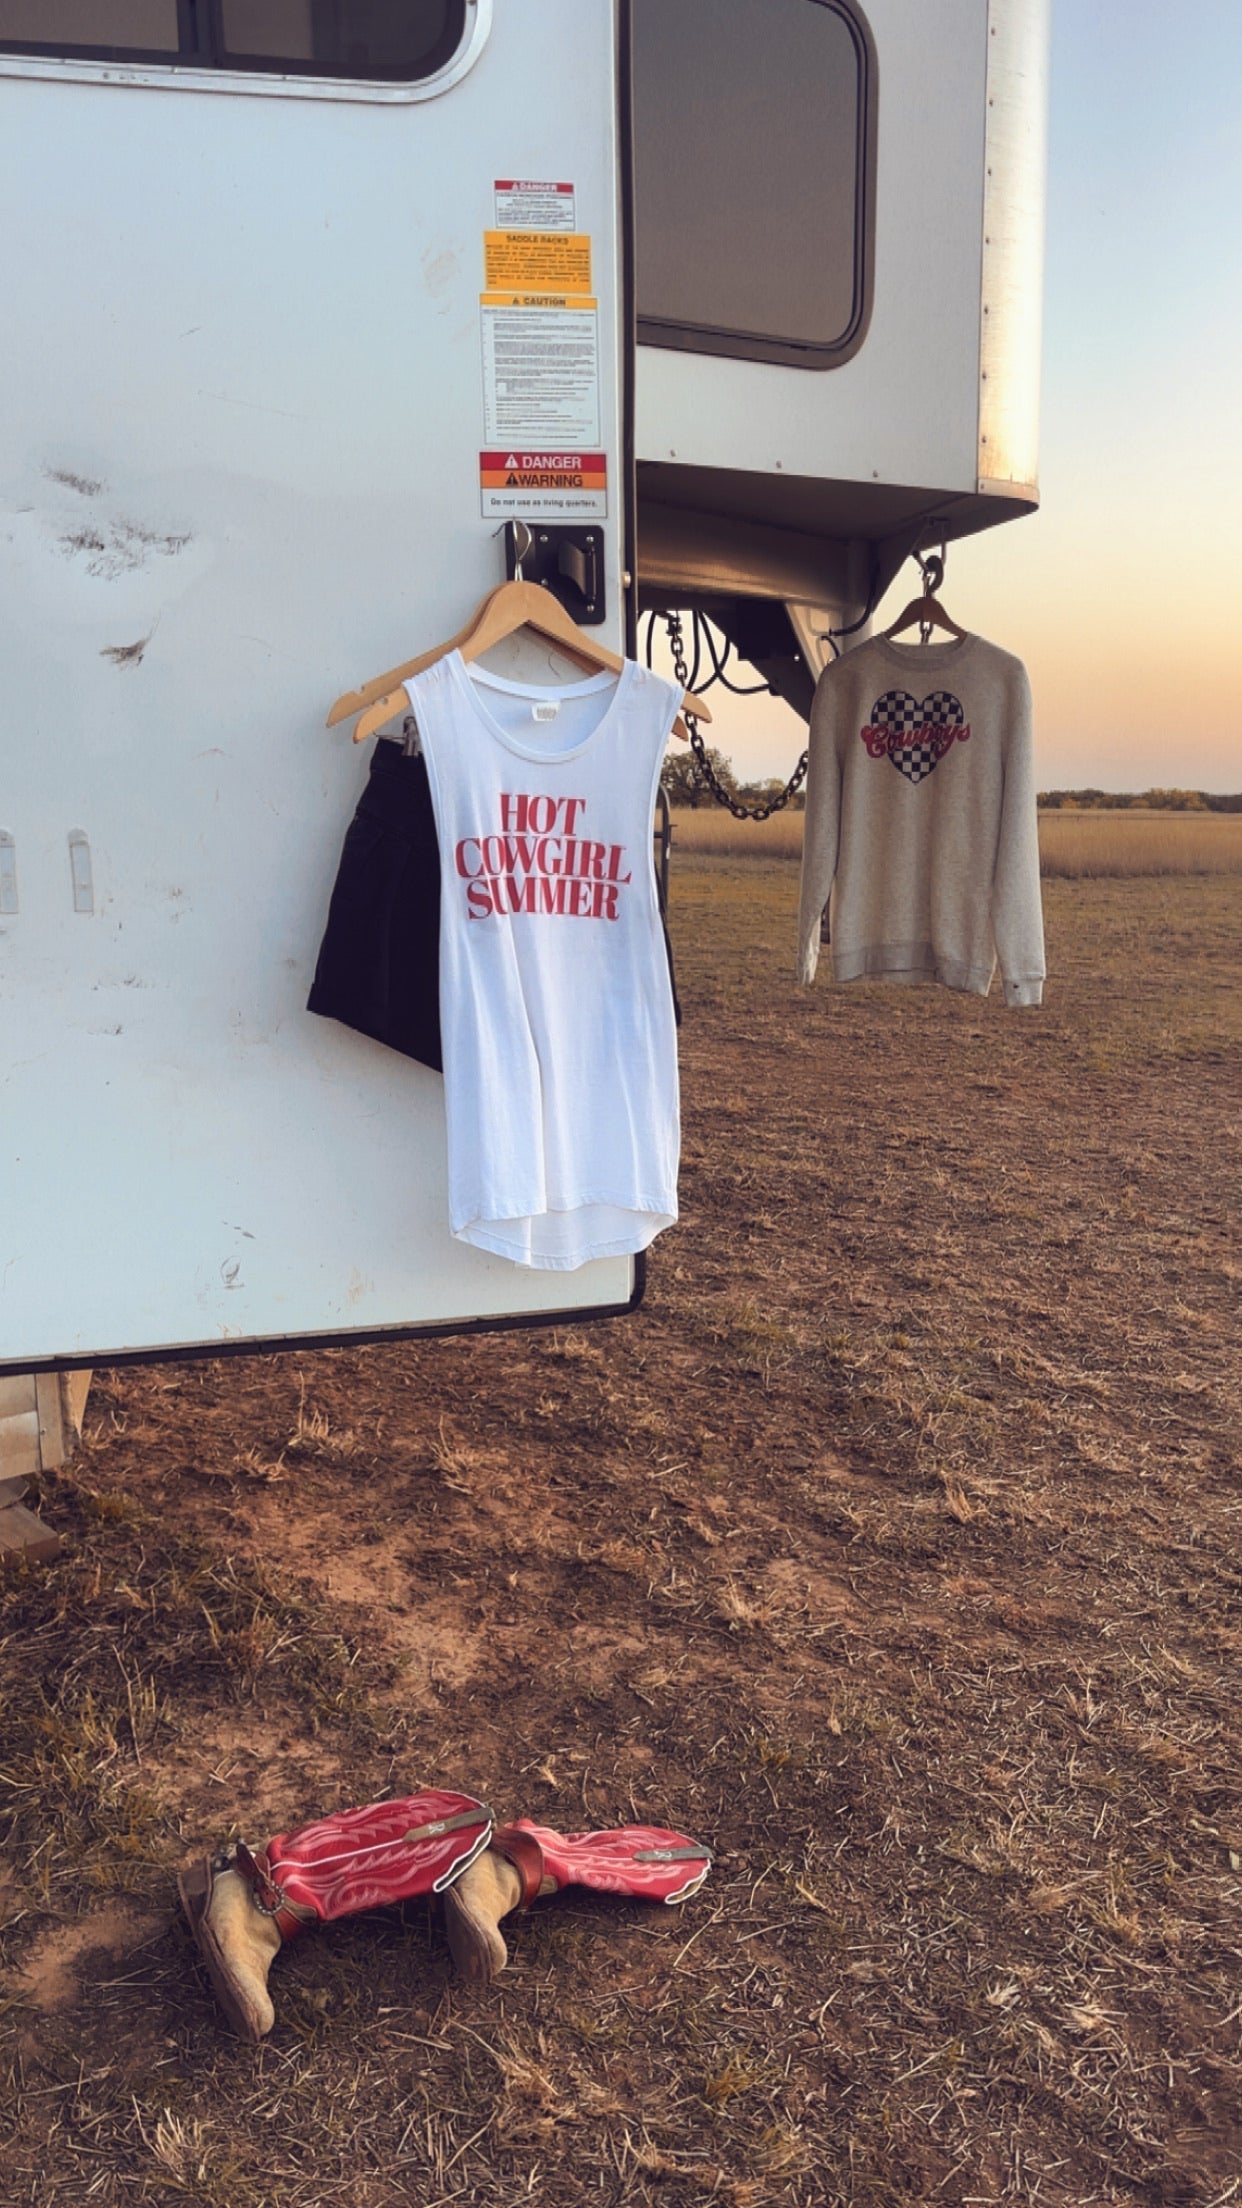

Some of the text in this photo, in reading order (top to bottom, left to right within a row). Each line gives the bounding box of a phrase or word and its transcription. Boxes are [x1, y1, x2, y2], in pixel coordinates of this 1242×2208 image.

[523, 297, 566, 306] CAUTION
[522, 456, 582, 469] DANGER
[518, 474, 583, 487] WARNING
[543, 499, 563, 507] living
[860, 722, 971, 760] Cowboys
[499, 793, 586, 836] HOT
[455, 834, 632, 884] COWGIRL
[466, 876, 620, 922] SUMMER
